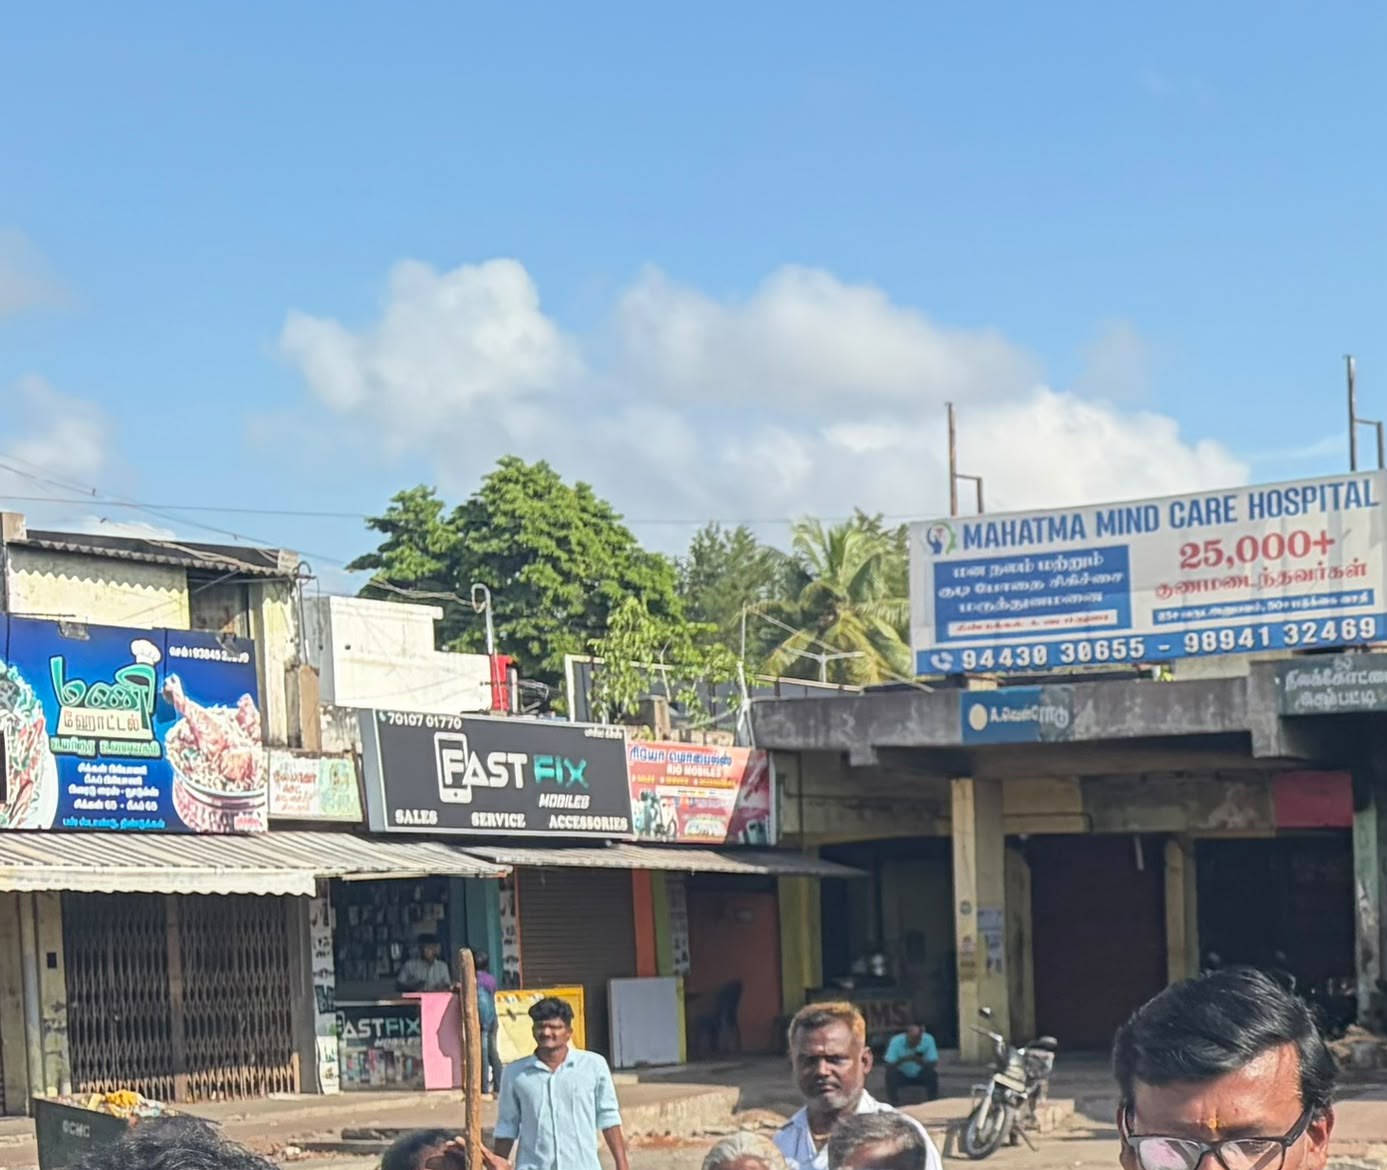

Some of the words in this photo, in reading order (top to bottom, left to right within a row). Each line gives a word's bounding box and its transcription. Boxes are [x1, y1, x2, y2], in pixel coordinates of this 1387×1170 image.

[962, 513, 1087, 550] MAHATMA
[1095, 504, 1160, 538] MIND
[1169, 494, 1239, 529] CARE
[1247, 479, 1382, 521] HOSPITAL
[1179, 528, 1335, 571] 25,000+
[1038, 551, 1104, 574] மற்றும்
[961, 644, 1048, 671] 94430
[1060, 636, 1146, 664] 30655
[1183, 626, 1270, 654] 98941
[1283, 617, 1376, 645] 32469
[63, 711, 141, 733] ஹோட்டல்
[388, 713, 423, 727] 70107
[426, 715, 462, 730] 01770
[441, 747, 528, 789] FAST
[533, 754, 590, 789] FIX
[538, 793, 590, 809] MOBILES
[395, 809, 438, 825] SALES
[471, 812, 526, 828] SERVICE
[549, 814, 629, 832] ACCESSORIES
